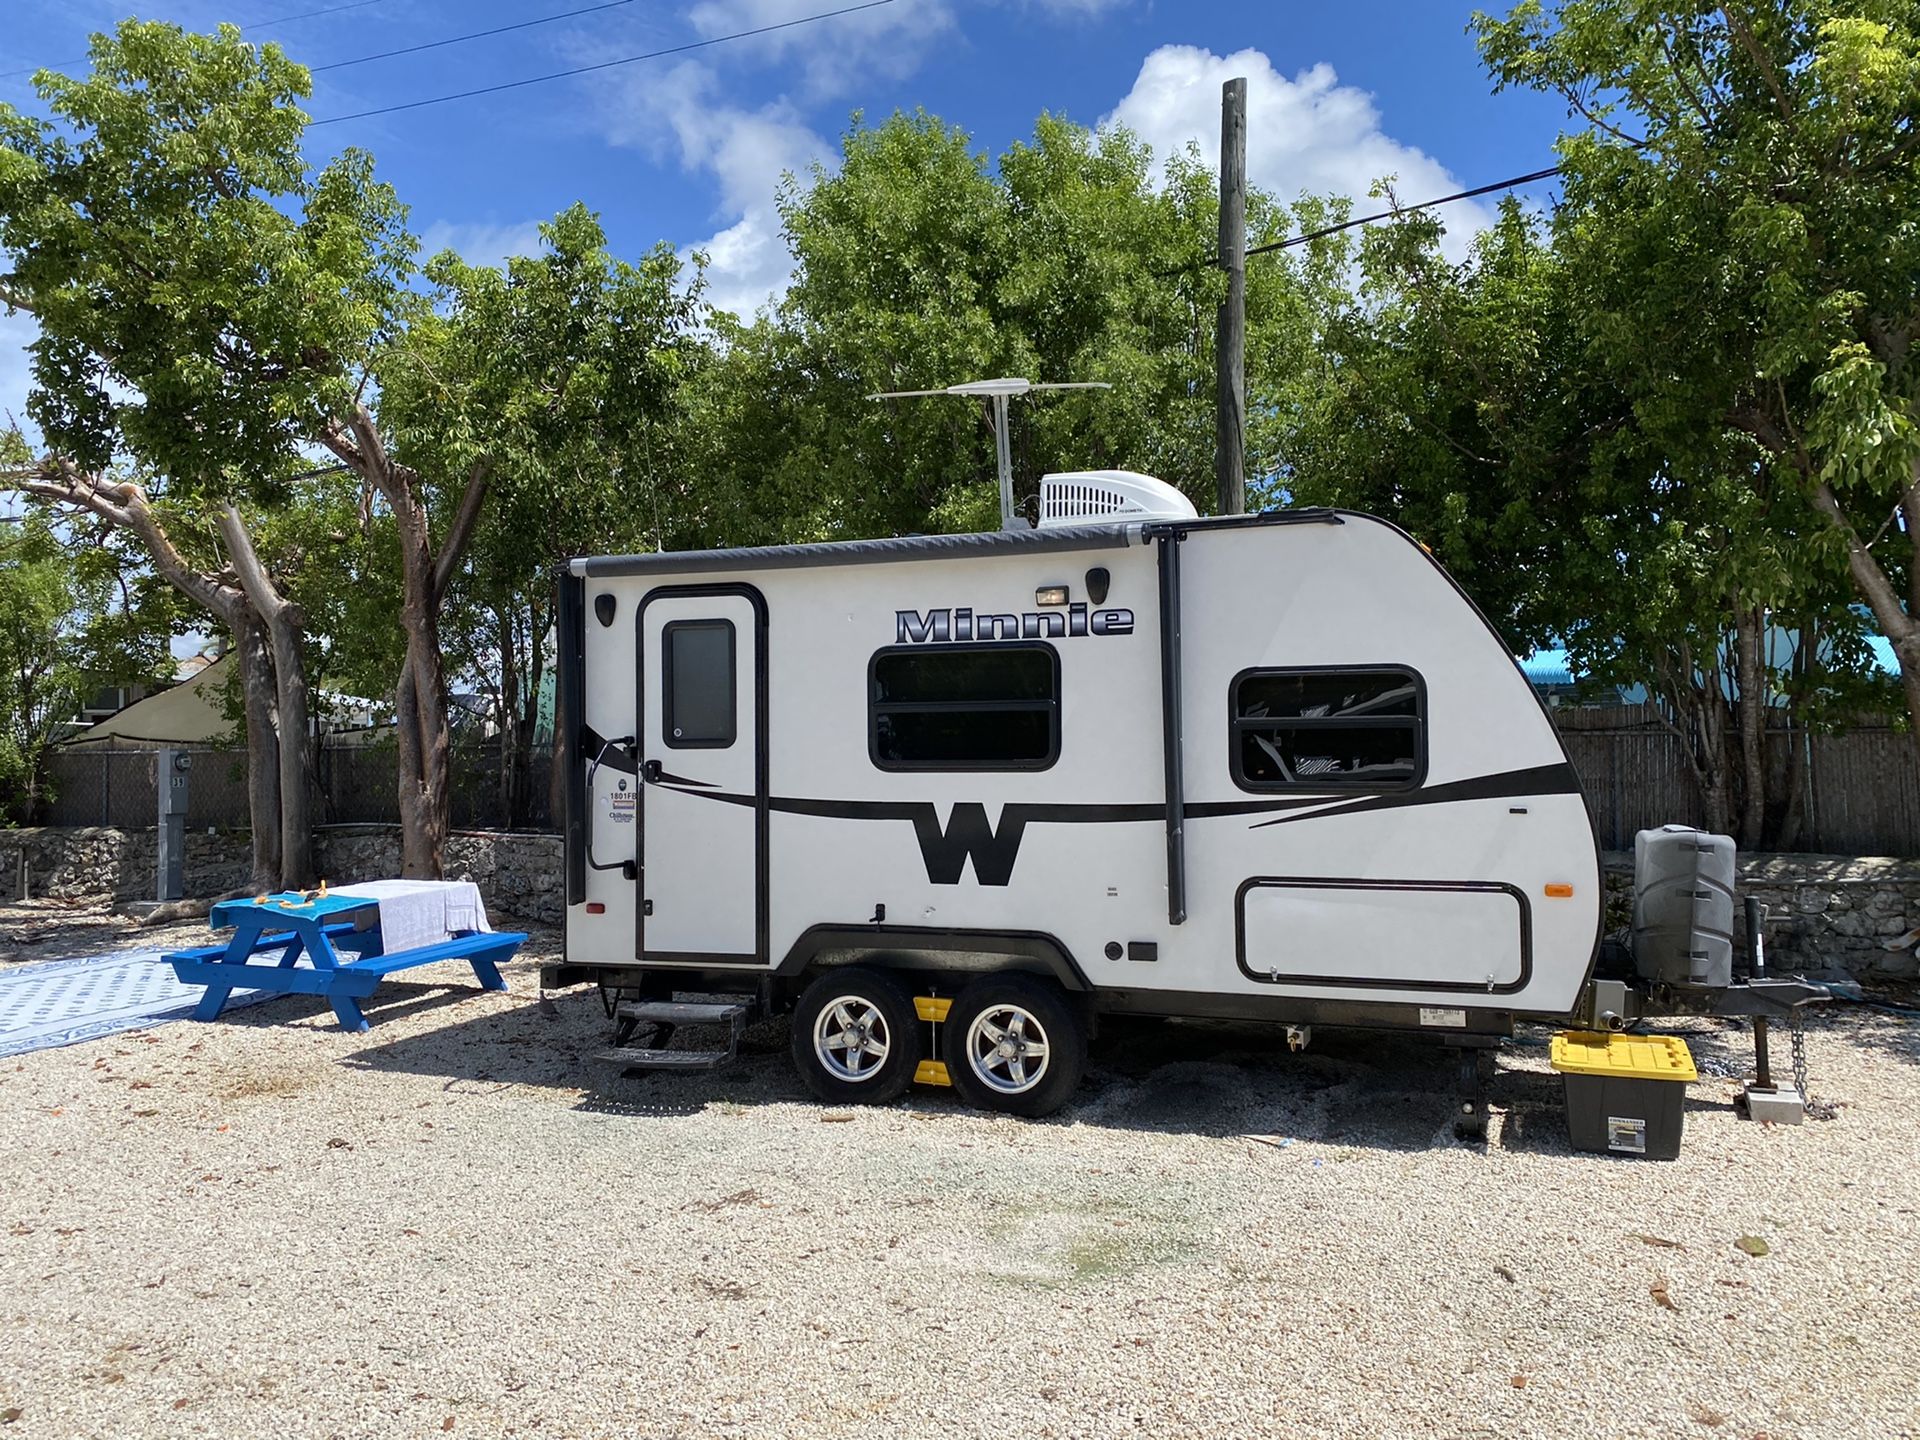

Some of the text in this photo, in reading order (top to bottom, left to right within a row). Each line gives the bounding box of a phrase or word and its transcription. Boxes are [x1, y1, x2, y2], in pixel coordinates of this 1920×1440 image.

[894, 601, 1135, 644] Minnie
[610, 792, 637, 800] 1801FB
[1609, 1117, 1644, 1125] COMMANDER
